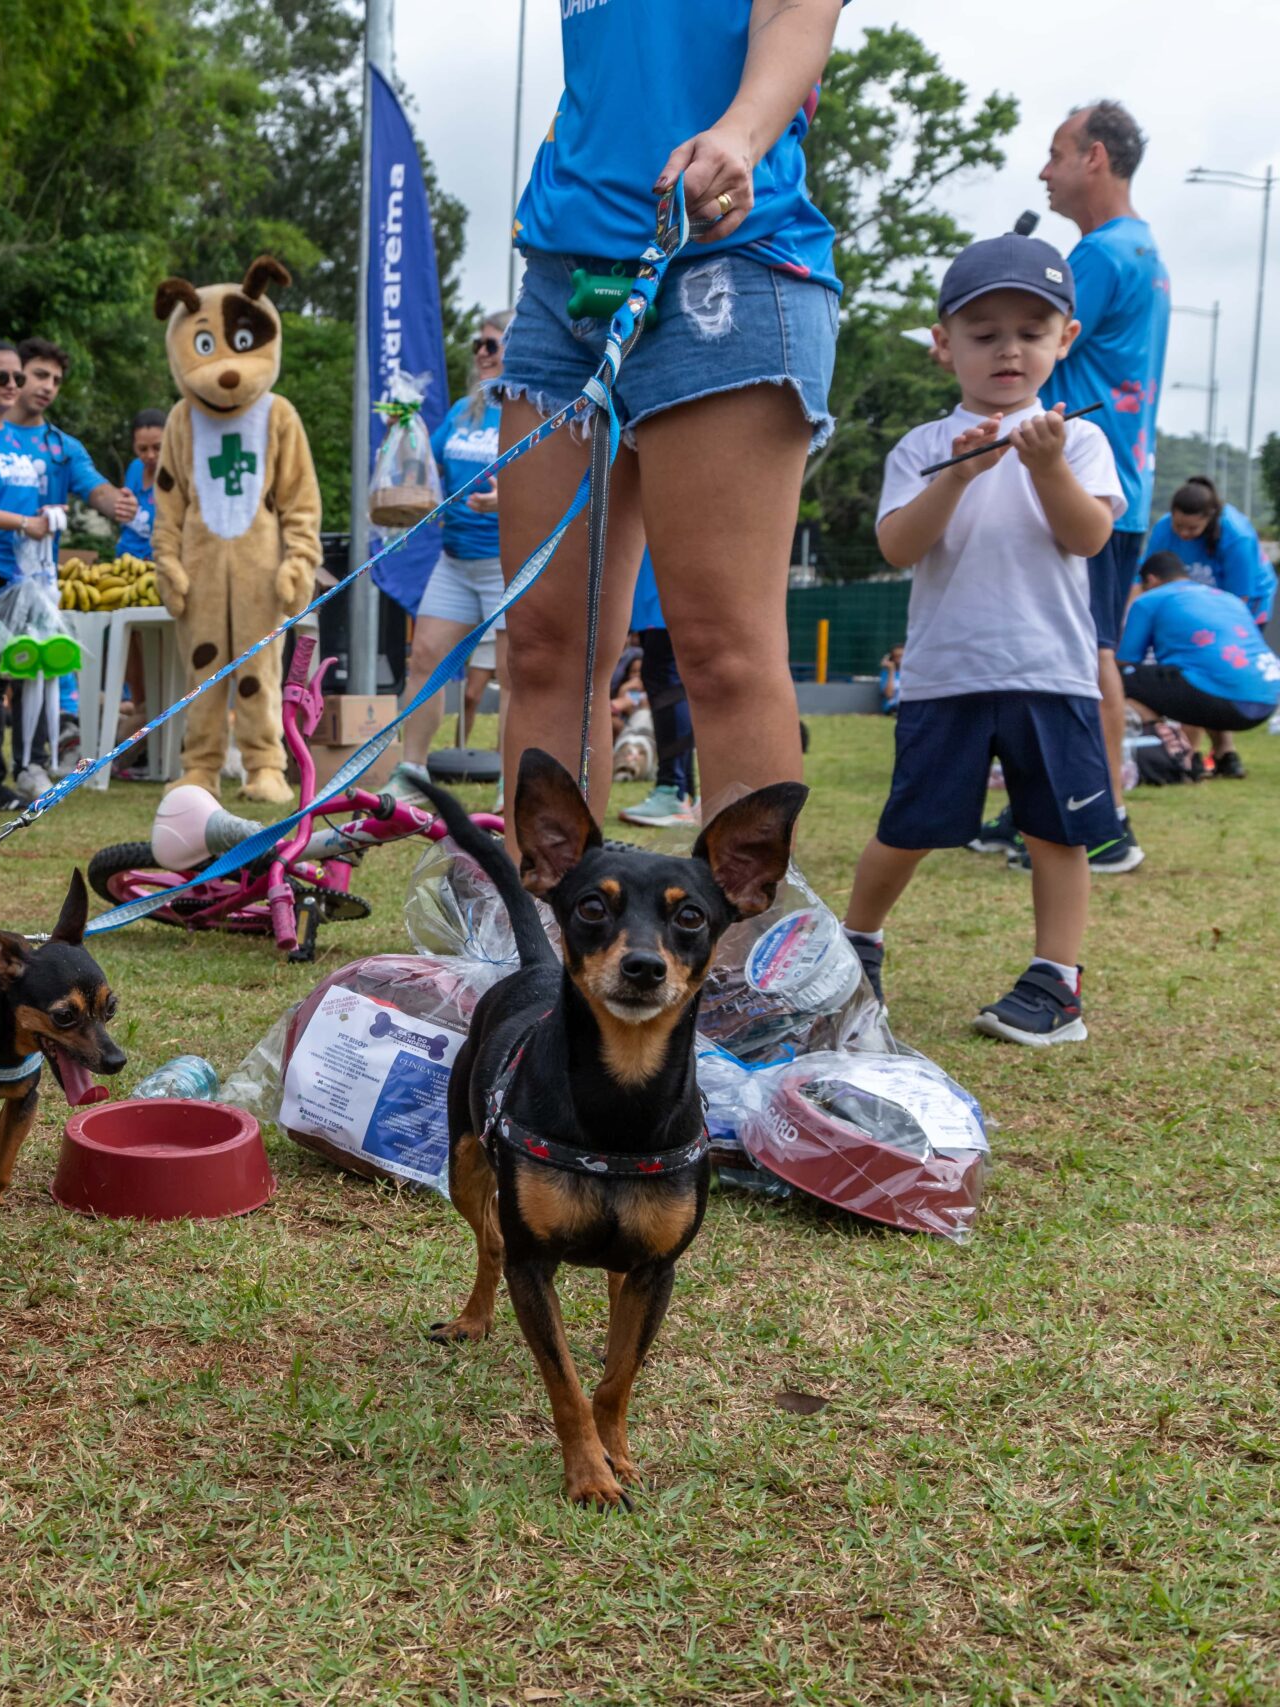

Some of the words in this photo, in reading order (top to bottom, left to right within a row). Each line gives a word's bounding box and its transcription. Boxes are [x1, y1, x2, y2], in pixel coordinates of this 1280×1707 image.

[337, 1032, 349, 1041] PET
[349, 1037, 369, 1048] SHOP
[388, 1030, 432, 1051] FAZENDEIRO
[398, 1030, 416, 1041] CASA
[399, 1058, 430, 1075] CLÍNICA
[303, 1108, 324, 1122] BANHO
[328, 1119, 344, 1130] TOSA
